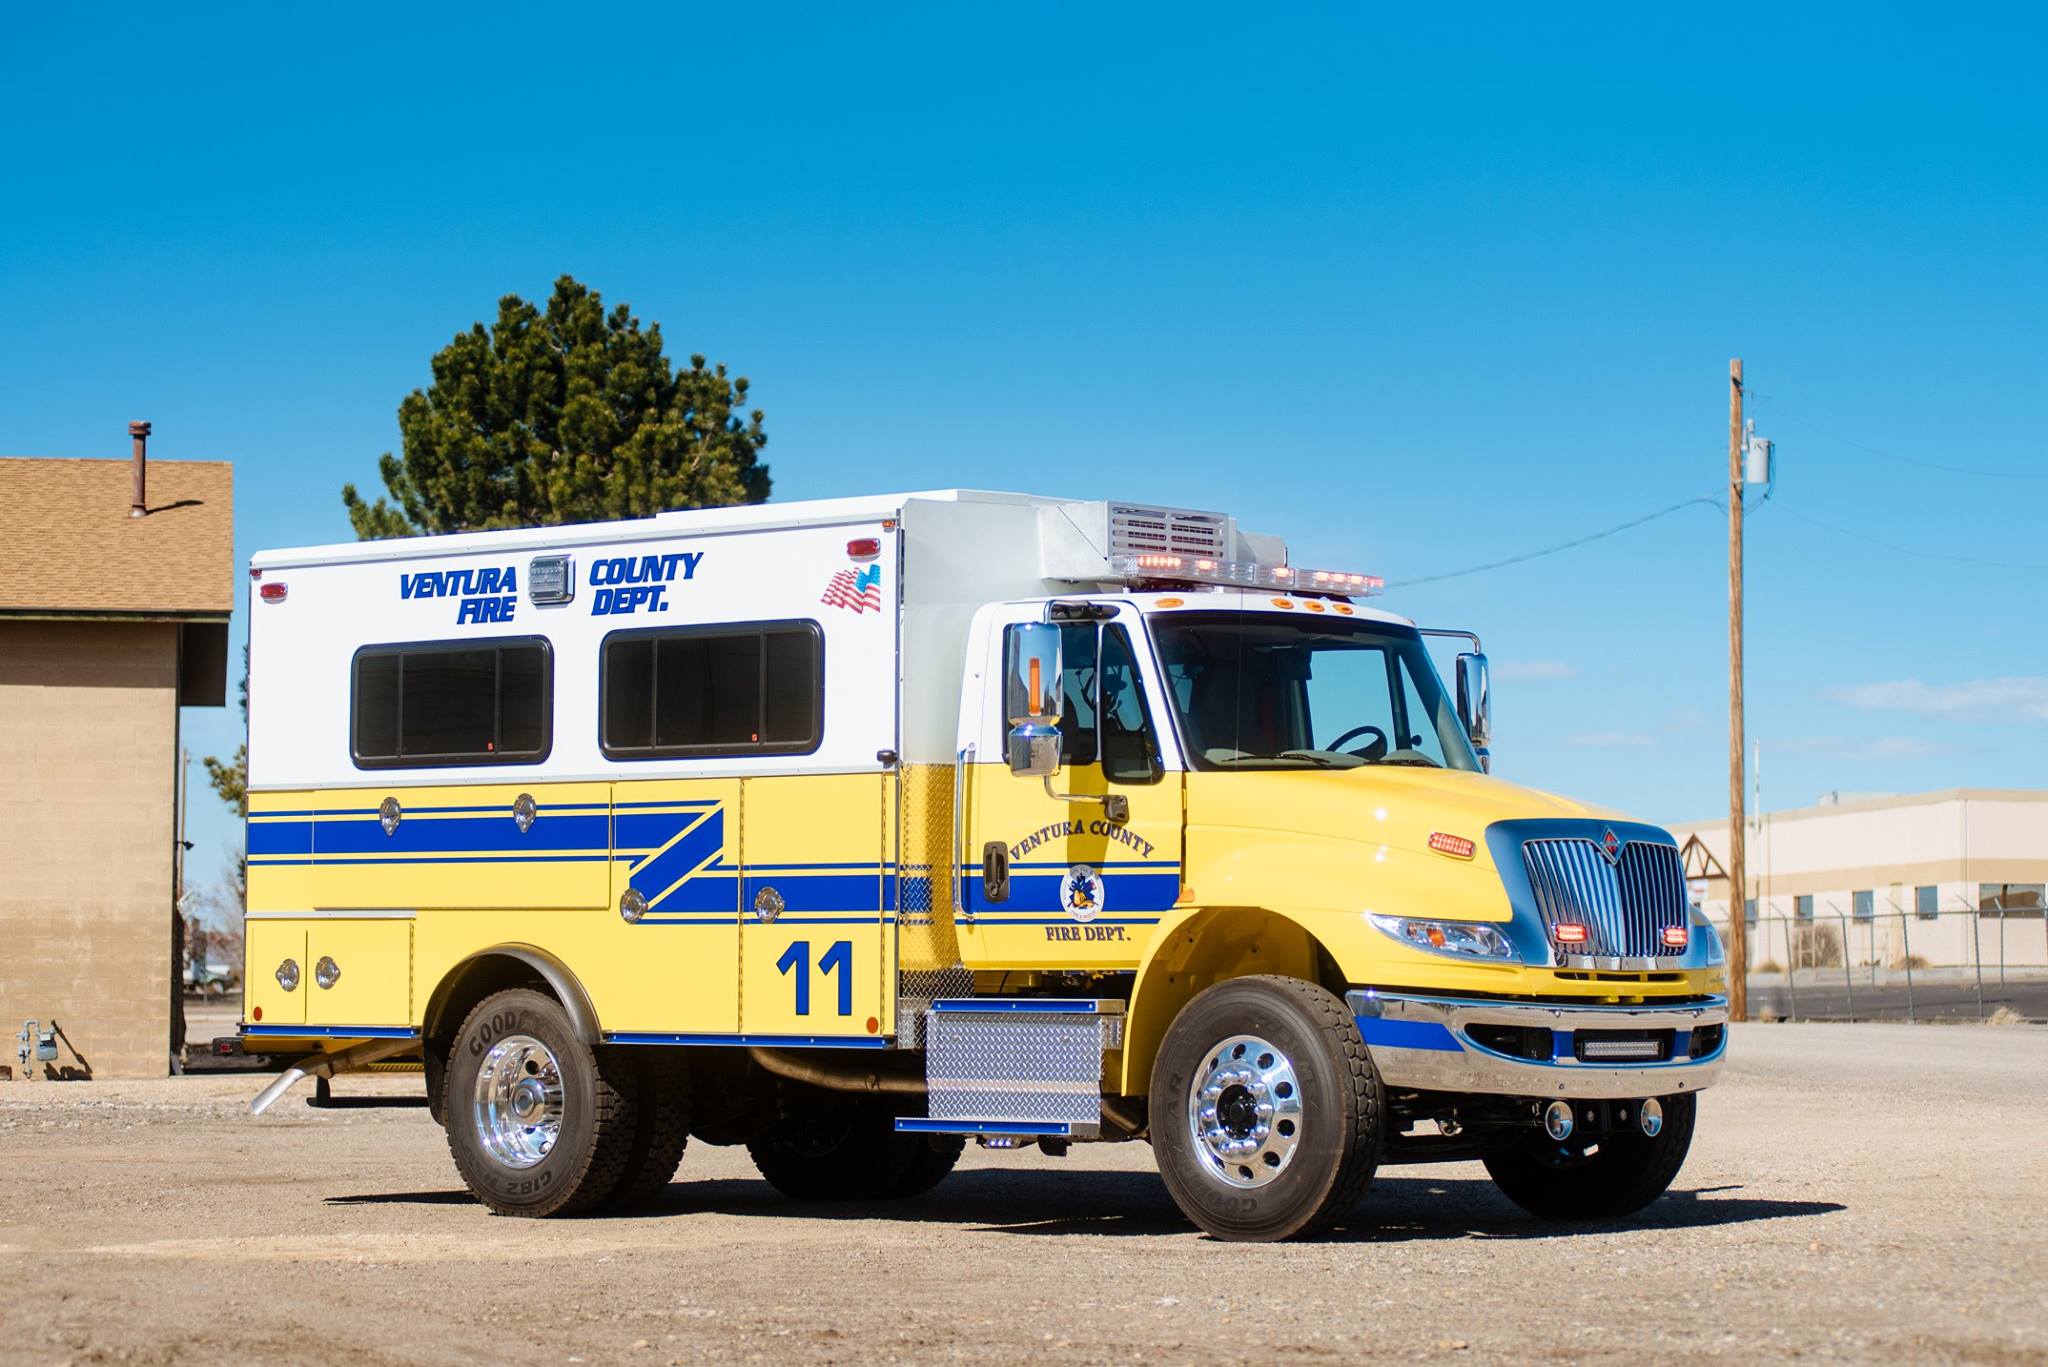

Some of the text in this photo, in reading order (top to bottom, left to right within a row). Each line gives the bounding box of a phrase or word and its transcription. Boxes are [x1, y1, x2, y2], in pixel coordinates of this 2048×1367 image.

[400, 552, 704, 599] VENTURA COUNTY
[456, 584, 669, 625] FIRE DEPT.
[1009, 819, 1155, 861] VENTURA COUNTY
[1045, 926, 1131, 941] FIRE DEPT.
[776, 940, 852, 1016] 11
